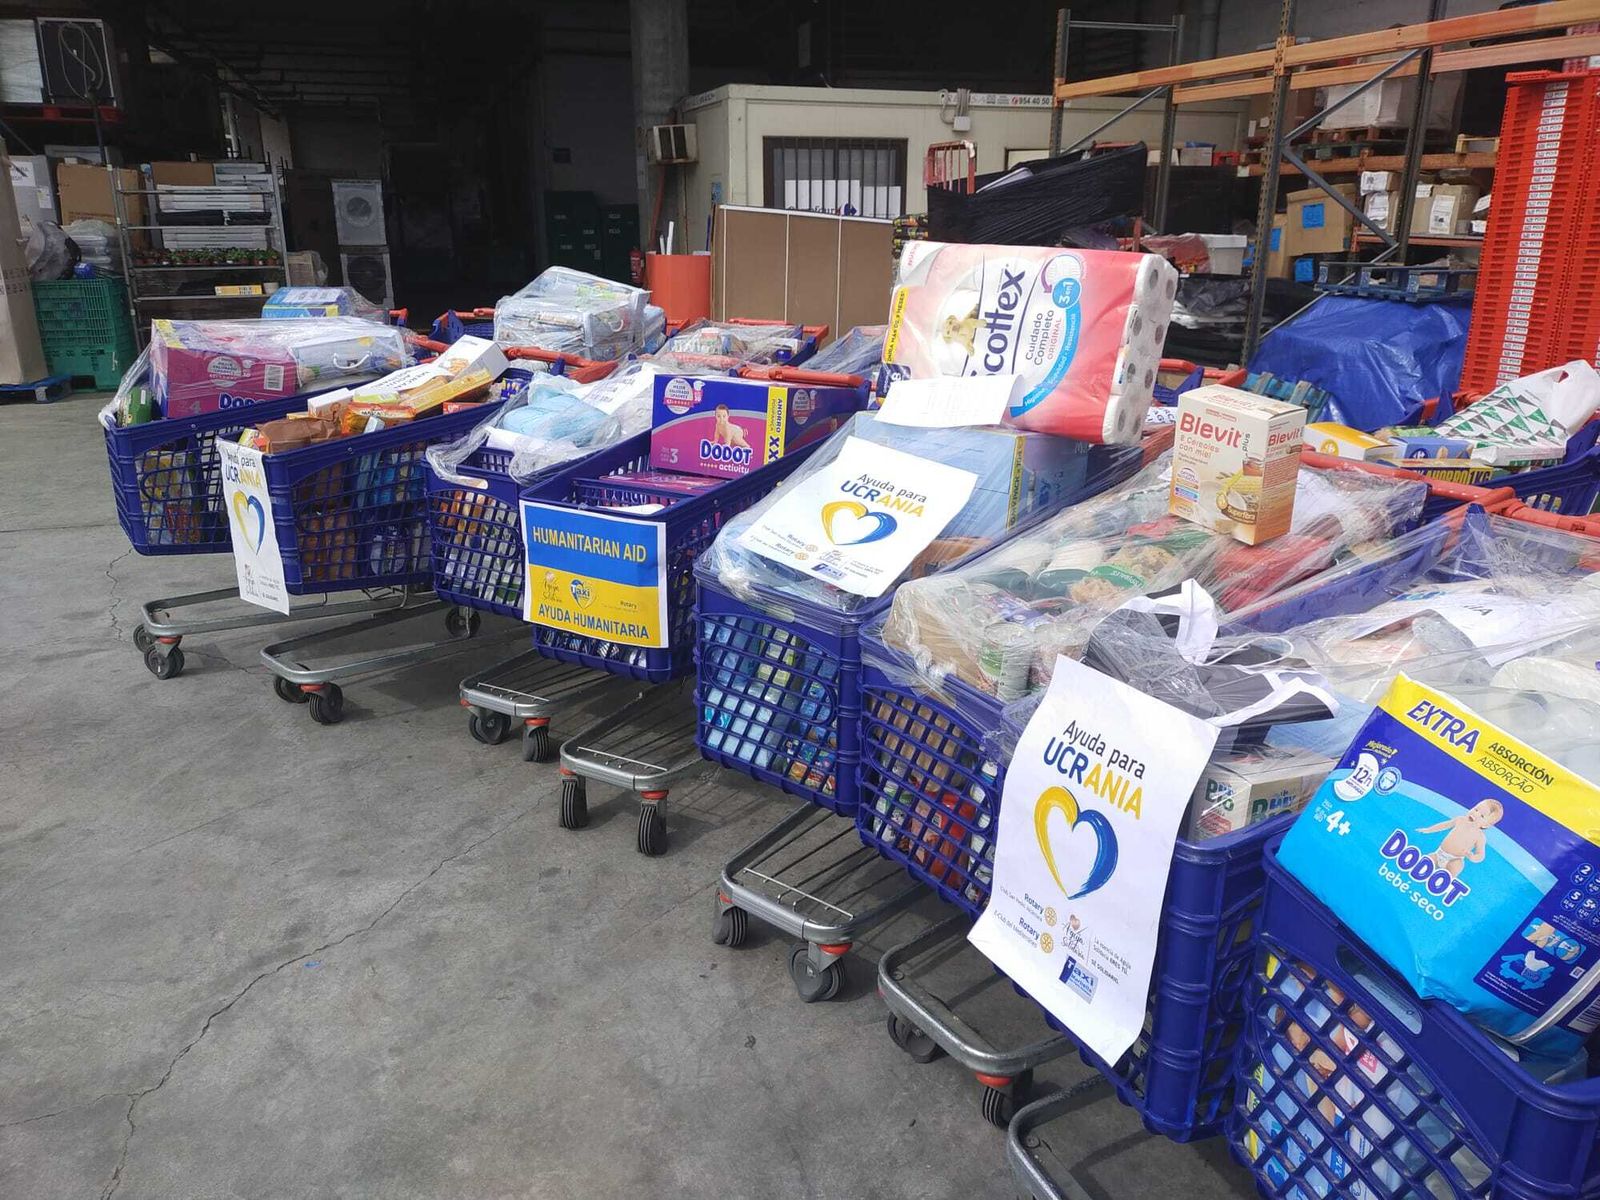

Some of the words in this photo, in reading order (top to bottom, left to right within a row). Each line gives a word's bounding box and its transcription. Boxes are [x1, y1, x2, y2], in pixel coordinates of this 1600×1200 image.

[971, 268, 1026, 376] cottex
[1026, 312, 1043, 360] Cuidado
[1034, 310, 1054, 365] Completo
[1047, 318, 1061, 360] ORIGINAL
[1179, 443, 1192, 452] con
[1180, 412, 1242, 448] Blevit
[1242, 433, 1250, 452] plus
[1269, 428, 1301, 447] Blevit
[241, 457, 257, 467] para
[671, 448, 679, 463] 3
[700, 439, 753, 465] DODOT
[225, 463, 262, 488] UCRANIA
[718, 462, 750, 475] activity
[840, 480, 925, 517] UCRANIA
[857, 473, 896, 492] Ayuda
[898, 487, 928, 504] para
[532, 526, 620, 560] HUMANITARIAN
[623, 543, 647, 563] AID
[538, 603, 571, 624] AYUDA
[573, 611, 650, 640] HUMANITARIA
[1406, 699, 1480, 754] EXTRA
[1063, 719, 1106, 758] Ayuda
[1107, 748, 1146, 780] para
[1488, 742, 1554, 786] ABSORCIÓN
[1043, 736, 1143, 820] UCRANIA
[1353, 766, 1373, 787] 12h
[1477, 756, 1535, 794] ABSORÇÃO
[1325, 810, 1351, 836] 4+
[1380, 828, 1471, 907] DODOT
[1580, 865, 1591, 875] 2
[1024, 893, 1045, 915] Rotary
[1571, 891, 1581, 900] 5
[1019, 917, 1040, 941] Rotary
[1067, 959, 1095, 987] Taxi
